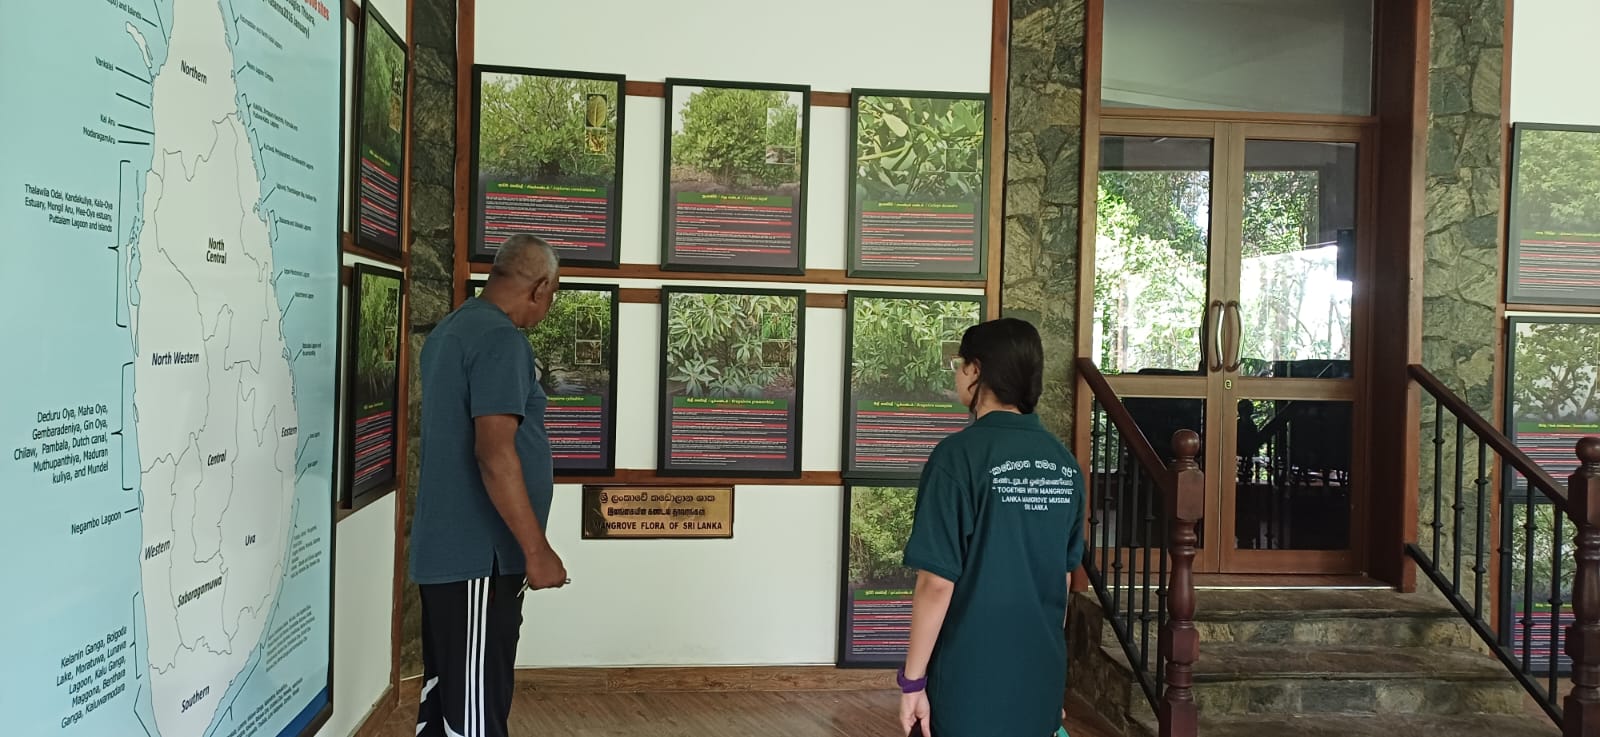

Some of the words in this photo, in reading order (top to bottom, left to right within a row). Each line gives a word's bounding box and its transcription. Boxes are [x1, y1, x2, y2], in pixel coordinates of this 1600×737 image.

[181, 60, 208, 84] Northern
[24, 197, 46, 210] Estuary,
[65, 204, 75, 215] Aru,
[72, 218, 88, 229] Lagoon
[88, 221, 98, 230] and
[208, 238, 224, 250] North
[206, 250, 227, 264] Central
[152, 352, 172, 366] North
[173, 352, 200, 365] Western
[37, 410, 61, 424] Deduru
[62, 408, 76, 420] Oya,
[78, 404, 94, 417] Maha
[95, 404, 108, 416] Oya,
[84, 420, 94, 431] Gin
[94, 418, 108, 430] Oya,
[280, 426, 298, 438] Eastern
[14, 446, 38, 461] Chilaw,
[42, 440, 71, 454] Pambala,
[72, 434, 90, 448] Dutch
[83, 448, 109, 462] Maduran
[207, 448, 227, 466] Central
[74, 465, 86, 479] and
[88, 460, 109, 476] Mundel
[997, 486, 1026, 494] TOGETHER
[71, 518, 100, 536] Negambo
[101, 511, 122, 526] Lagoon
[640, 522, 665, 530] FLORA
[670, 522, 679, 530] OF
[683, 522, 696, 530] SRI
[697, 522, 722, 530] LANKA
[244, 534, 256, 547] Uva
[144, 540, 171, 560] Western
[177, 576, 223, 608] Sabaragamuwa
[84, 640, 106, 656] Ganga,
[56, 671, 74, 687] Lake,
[76, 653, 106, 676] Moratuwa,
[107, 640, 127, 658] Lunawa
[68, 675, 94, 695] Lagoon,
[94, 664, 108, 680] Kalu
[180, 685, 210, 714] Southern
